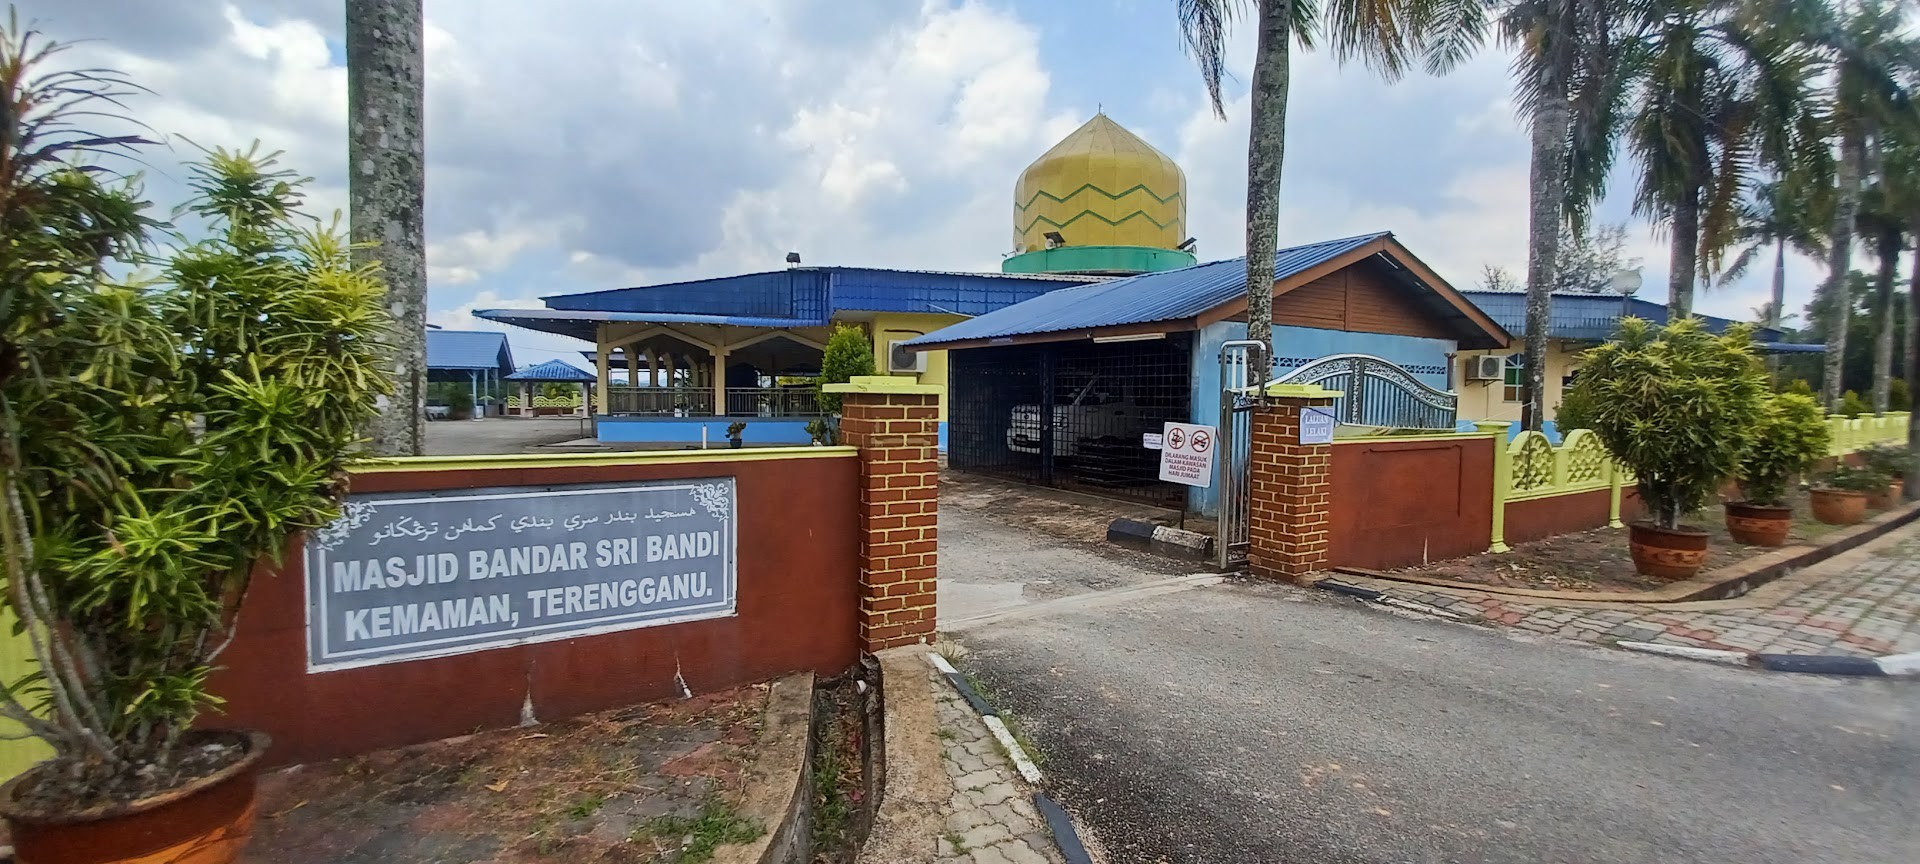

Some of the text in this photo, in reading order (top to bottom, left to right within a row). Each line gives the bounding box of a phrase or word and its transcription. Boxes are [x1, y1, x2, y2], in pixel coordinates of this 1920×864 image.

[1305, 415, 1329, 424] LALUAN
[1305, 427, 1327, 437] LELAKI
[1165, 452, 1188, 460] DILARANG
[510, 515, 554, 533] بندي
[563, 514, 599, 531] سري
[604, 510, 638, 525] بندر
[333, 530, 720, 593] MASJID BANDAR SRI BANDI
[345, 572, 713, 642] KEMAMAN, TERENGGANU.
